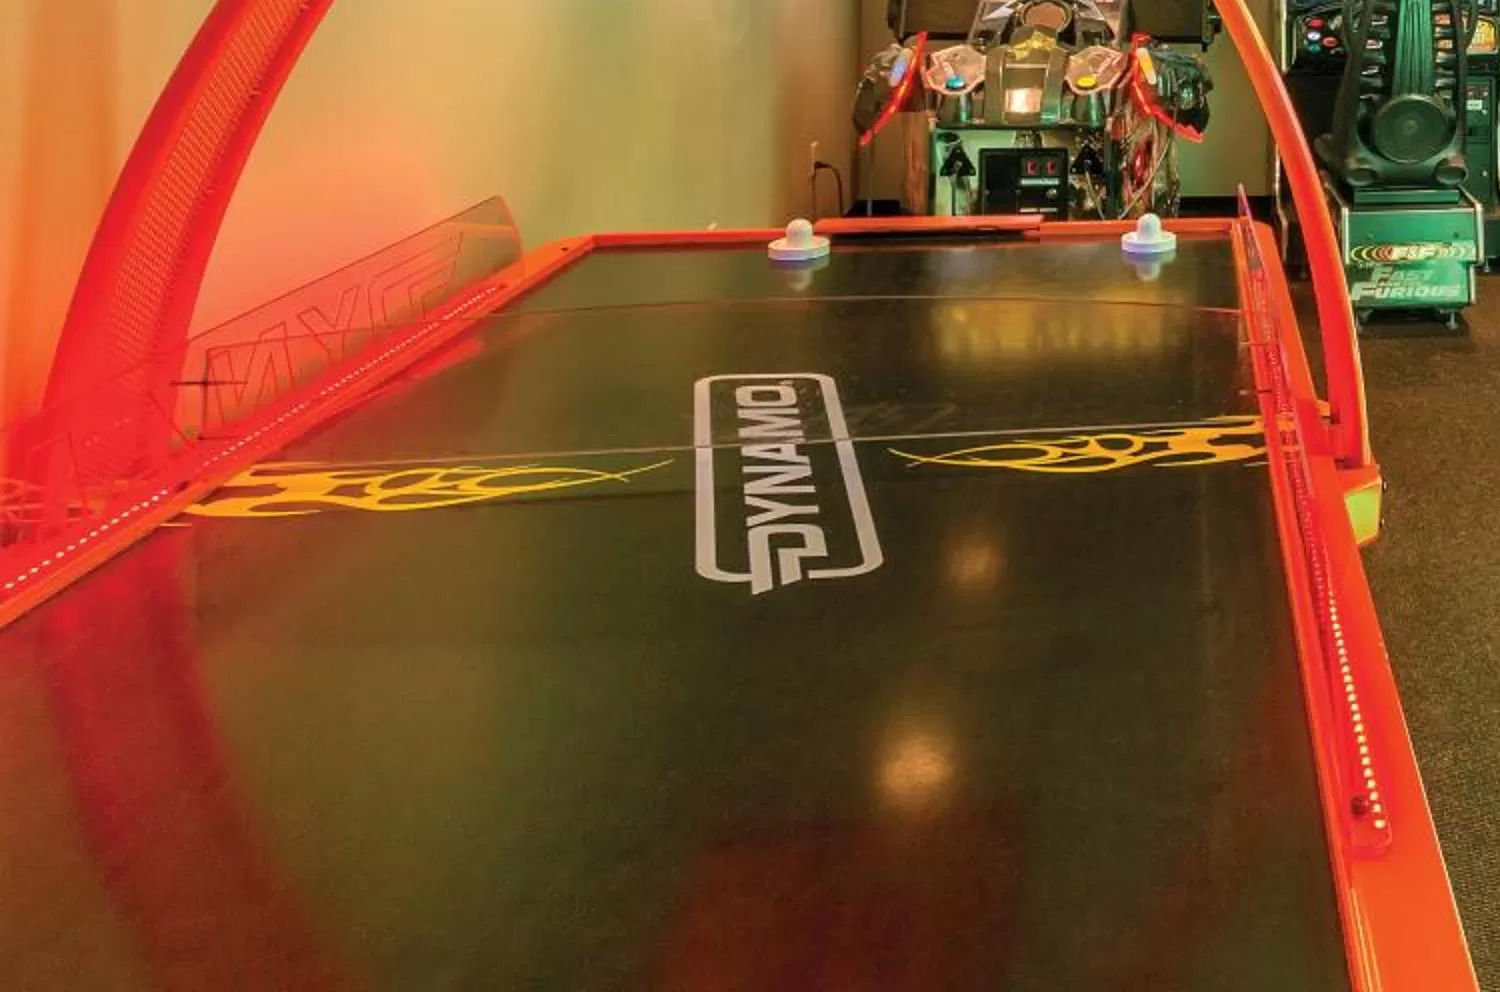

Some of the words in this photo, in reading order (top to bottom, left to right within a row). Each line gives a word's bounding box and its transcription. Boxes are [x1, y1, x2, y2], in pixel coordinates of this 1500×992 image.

[1371, 266, 1434, 282] FAST
[1350, 281, 1462, 301] FURIOUS
[735, 383, 829, 596] DYNAMO
